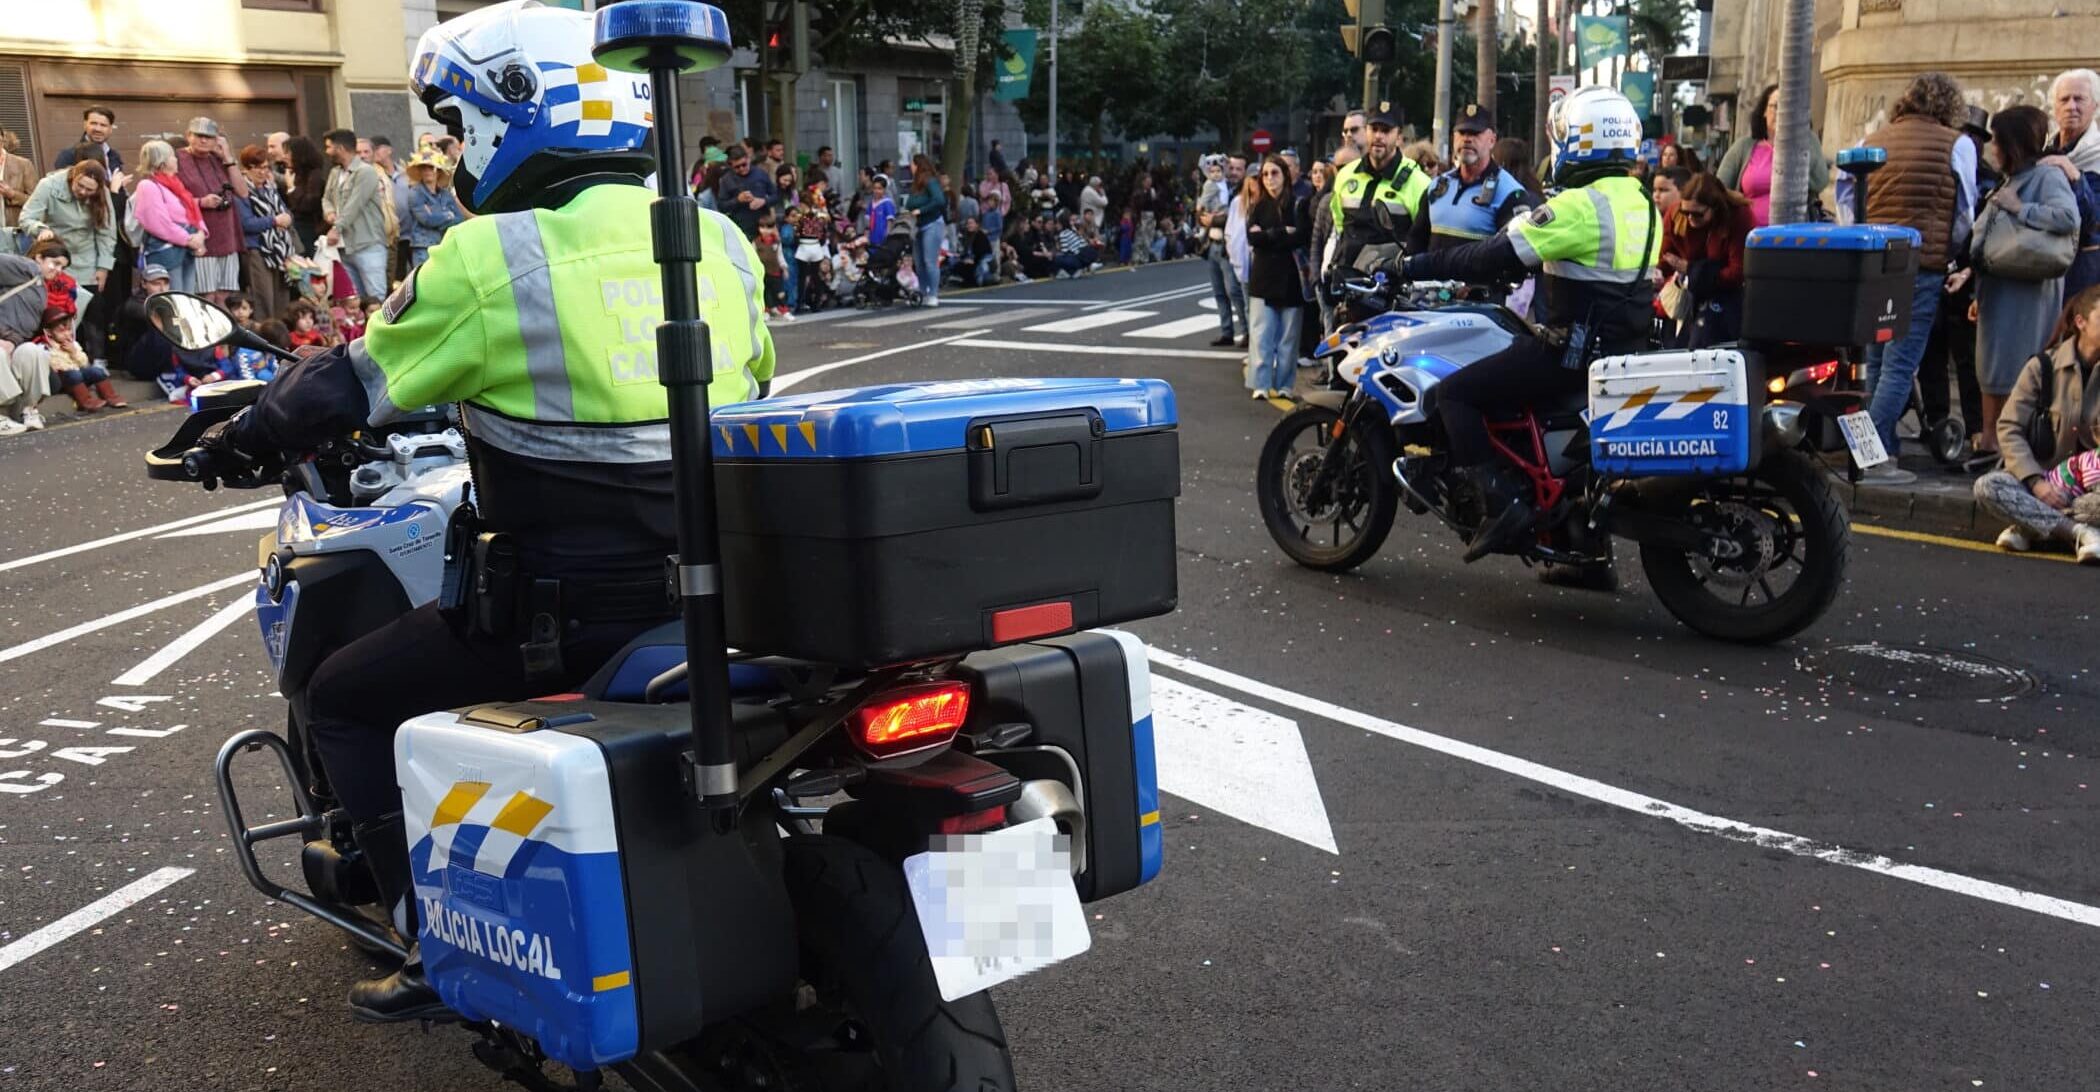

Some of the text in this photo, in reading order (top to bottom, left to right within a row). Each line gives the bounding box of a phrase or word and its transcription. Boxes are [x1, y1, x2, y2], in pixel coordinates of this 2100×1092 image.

[1602, 129, 1633, 139] LOCAL
[602, 276, 717, 309] POLA
[1713, 410, 1729, 430] 82
[1670, 440, 1717, 456] LOCAL
[484, 921, 562, 980] LOCAL
